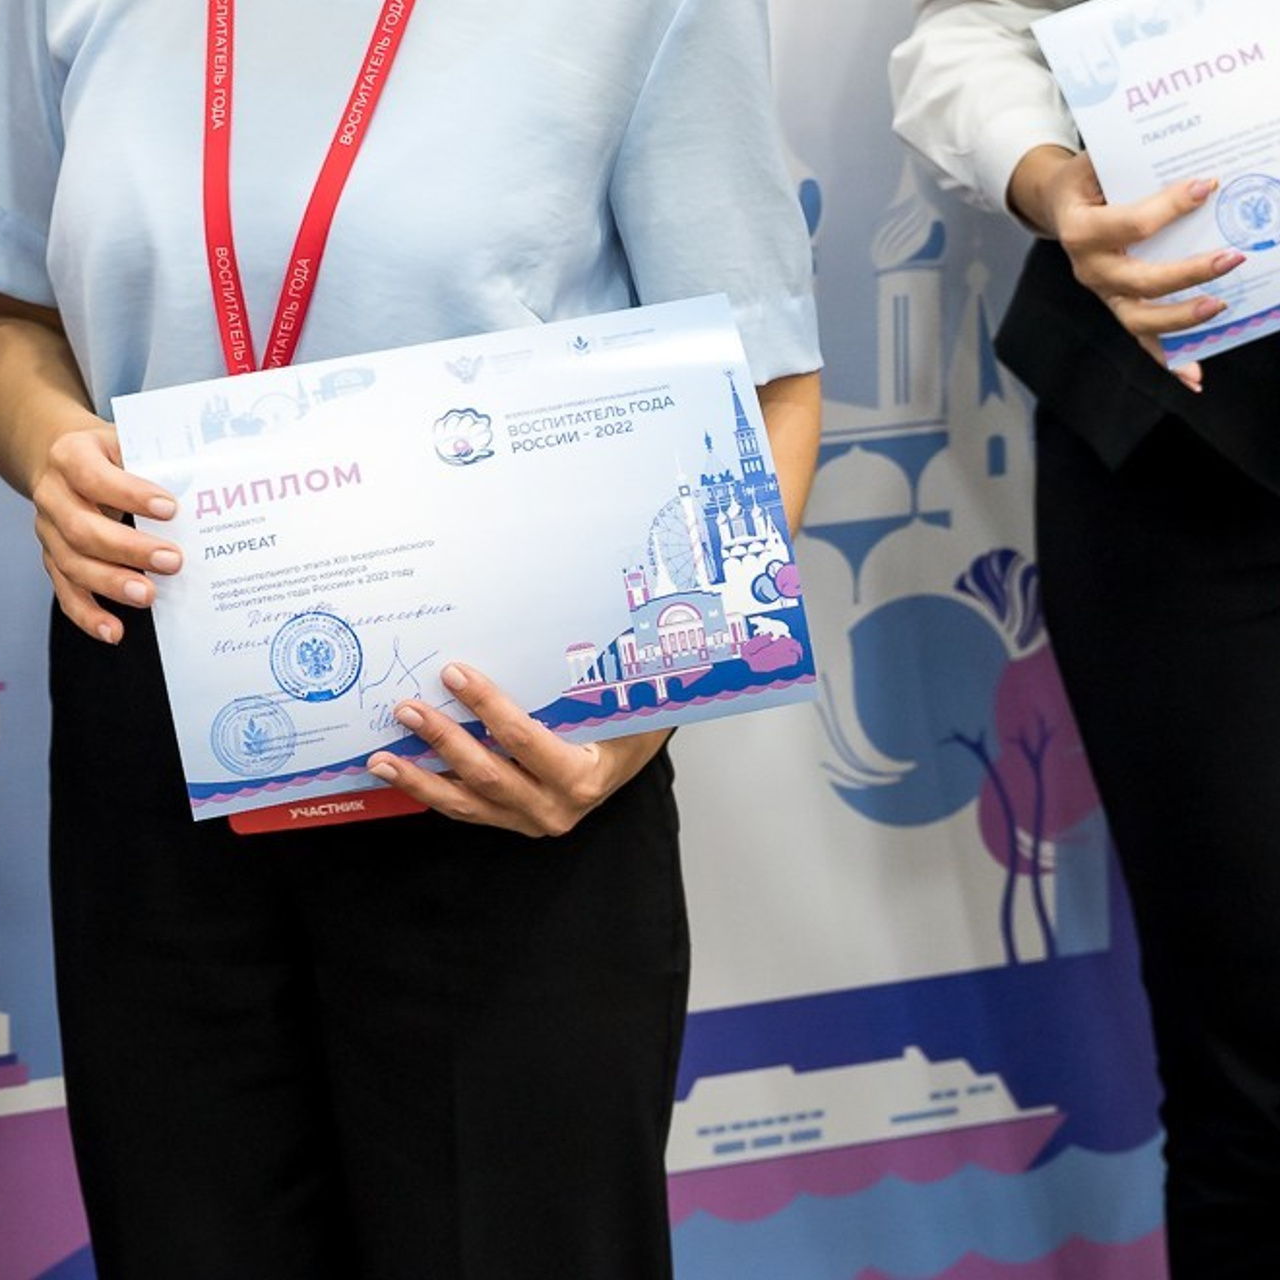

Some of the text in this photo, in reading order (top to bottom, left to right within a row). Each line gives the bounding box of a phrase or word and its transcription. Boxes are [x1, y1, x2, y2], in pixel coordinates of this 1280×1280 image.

[339, 36, 391, 146] ВОСПИТАТЕЛЬ
[1125, 42, 1265, 113] ДИПЛОМ
[212, 88, 227, 130] ГОДА
[288, 258, 311, 298] ГОДА
[215, 246, 248, 361] ВОСПИТАТЕЛЬ
[507, 405, 627, 438] ВОСПИТАТЕЛЬ
[629, 395, 676, 415] ГОДА
[511, 430, 580, 454] РОССИИ
[594, 419, 634, 439] 2022
[195, 462, 363, 520] ДИПЛОМ
[203, 533, 279, 561] ЛАУРЕАТ
[365, 572, 391, 585] 2022
[391, 568, 416, 582] году
[289, 798, 367, 821] УЧАСТНИК
